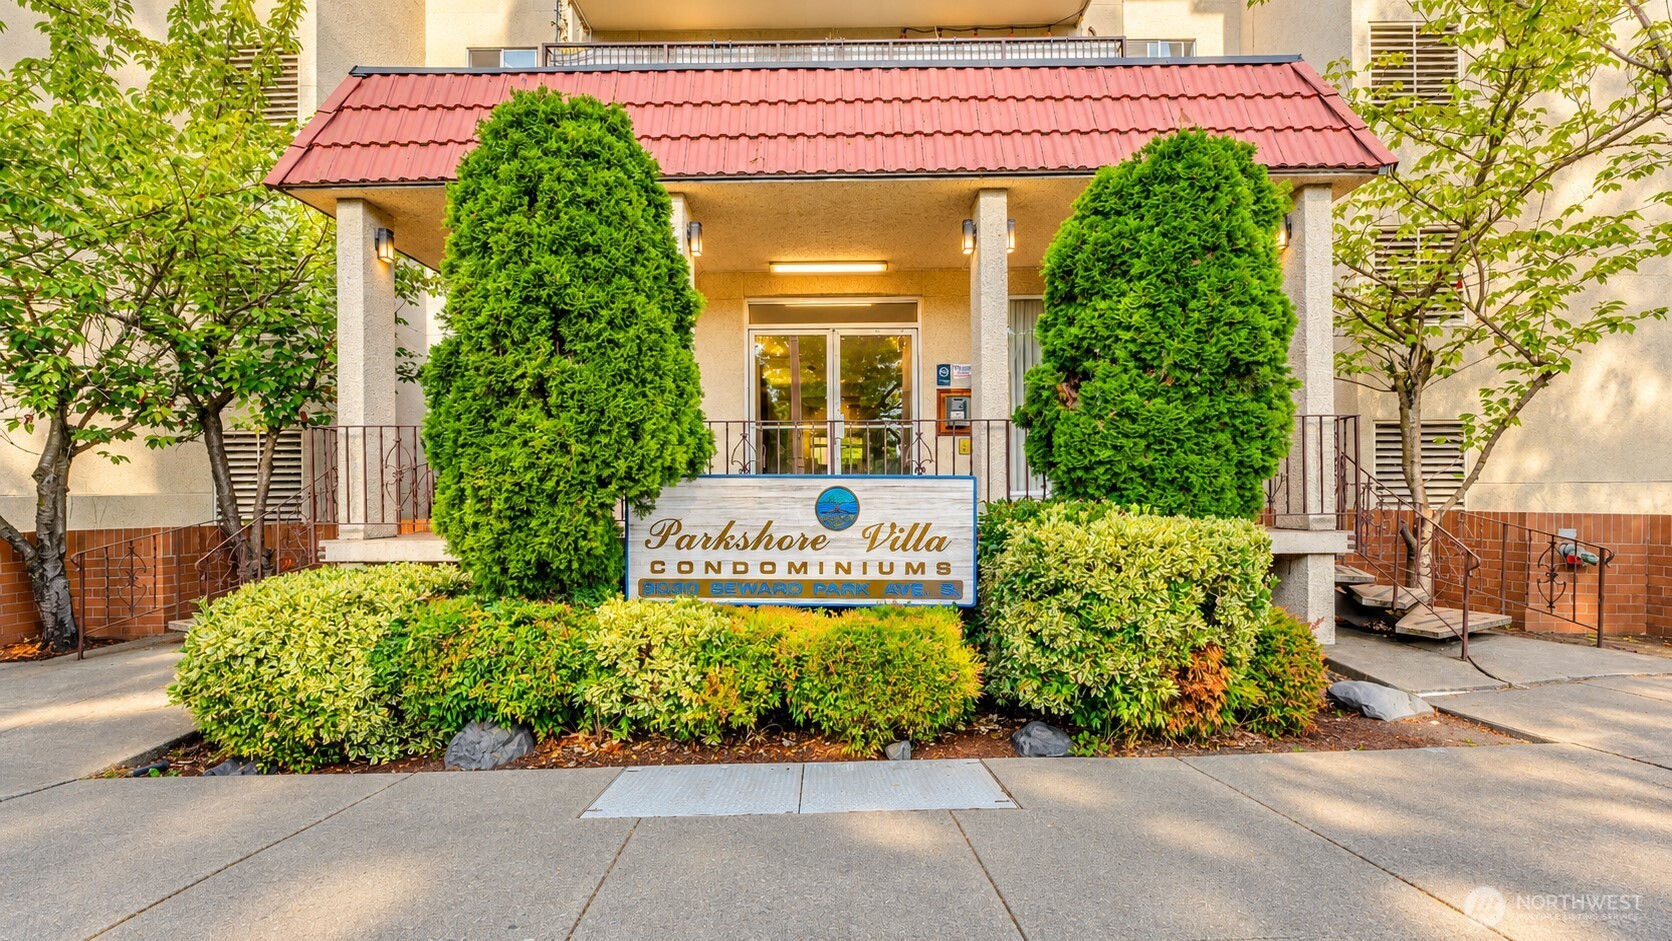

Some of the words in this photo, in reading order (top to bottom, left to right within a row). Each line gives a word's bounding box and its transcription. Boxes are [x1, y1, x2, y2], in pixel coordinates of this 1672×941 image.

[645, 518, 830, 551] Parkshore
[862, 521, 953, 553] Villa
[650, 560, 951, 575] CONDOMINIUMS
[710, 581, 803, 595] SEWARD
[813, 582, 870, 596] PARK
[884, 582, 929, 597] AVE.
